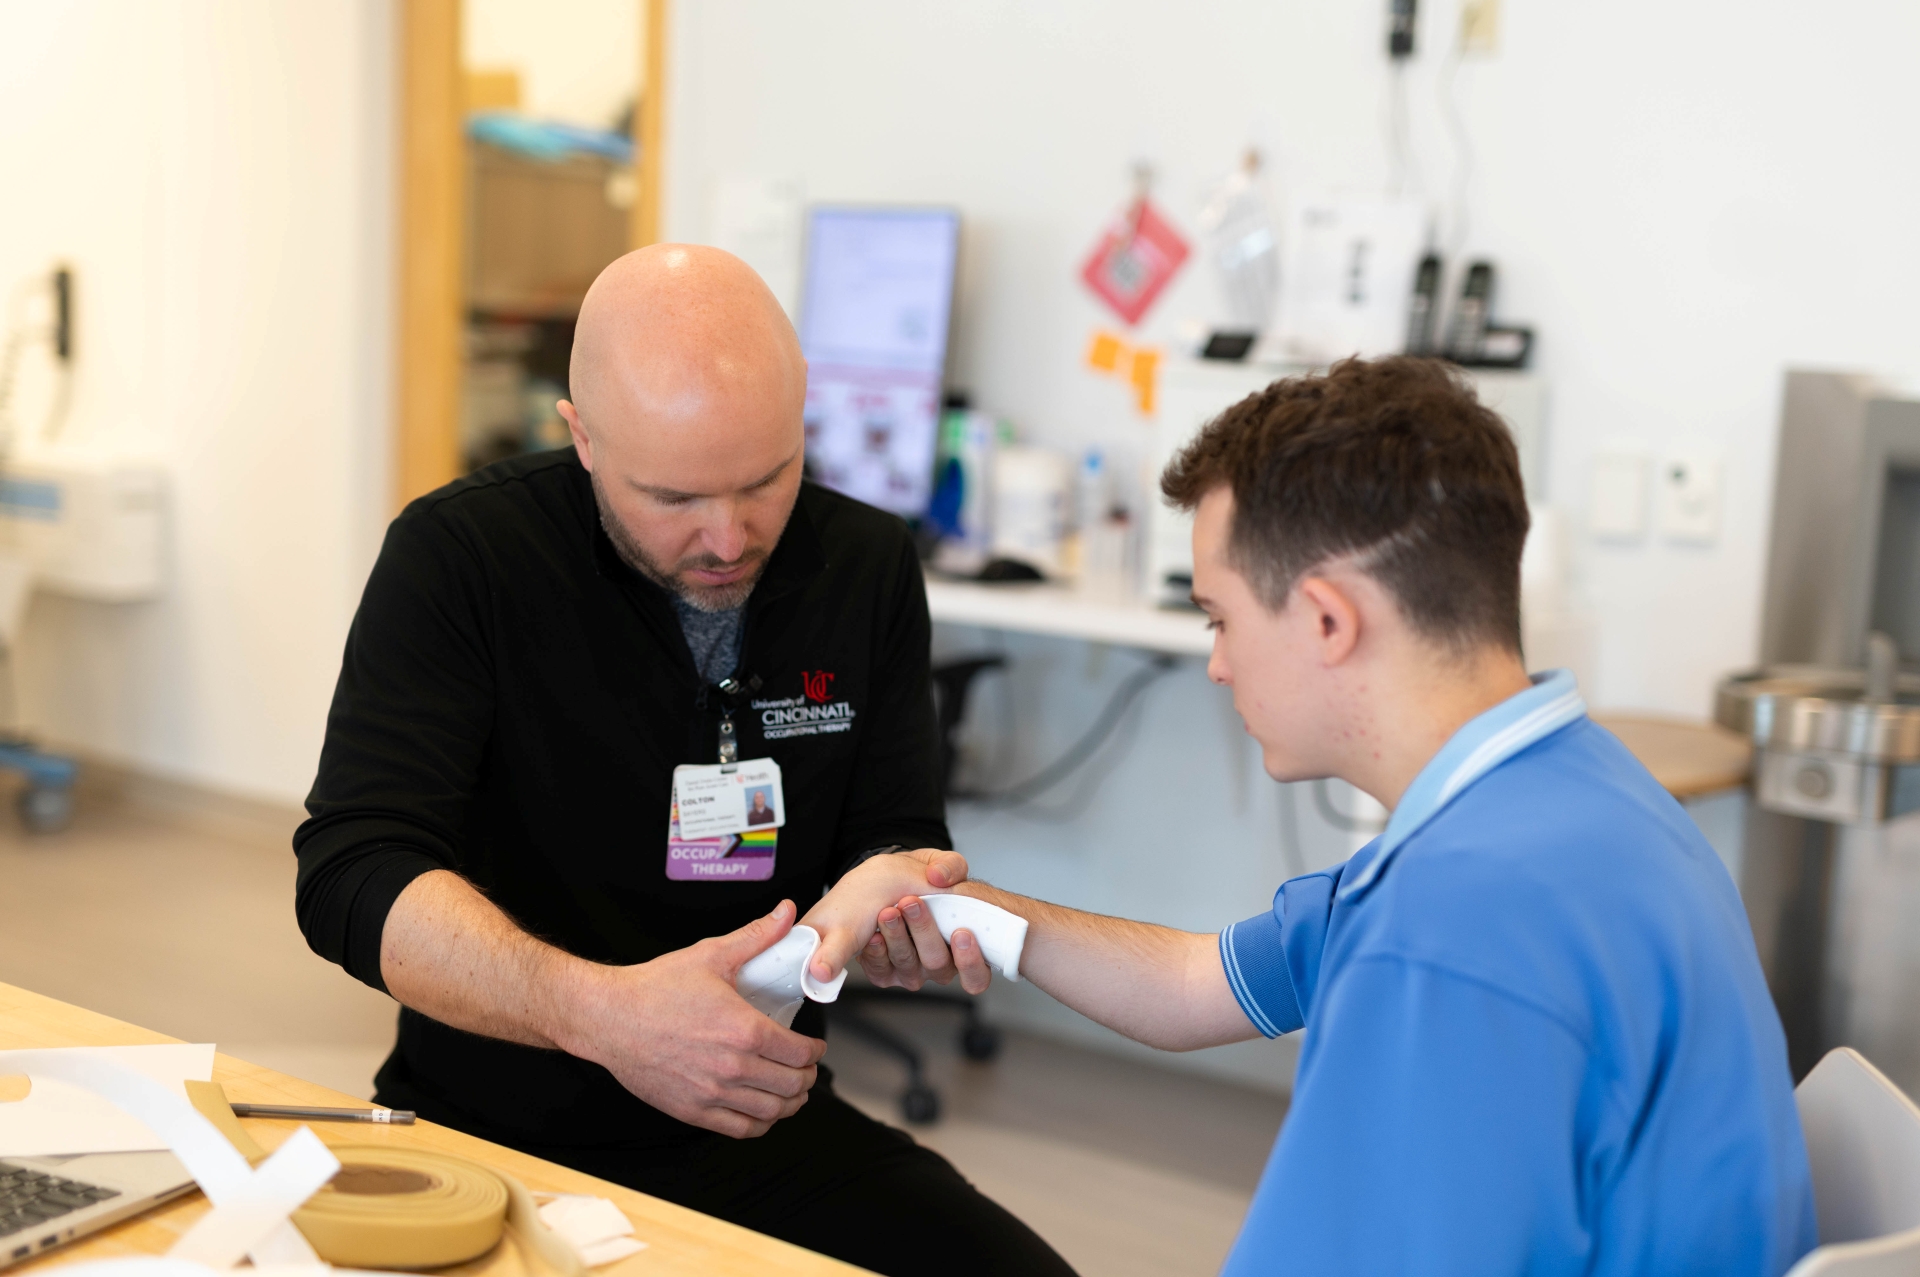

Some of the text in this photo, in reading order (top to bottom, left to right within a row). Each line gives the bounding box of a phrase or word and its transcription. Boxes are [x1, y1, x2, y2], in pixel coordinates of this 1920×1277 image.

[751, 694, 805, 710] University of
[762, 702, 850, 725] CINCINNATI
[682, 796, 715, 806] COLTON
[691, 863, 748, 875] THERAPY
